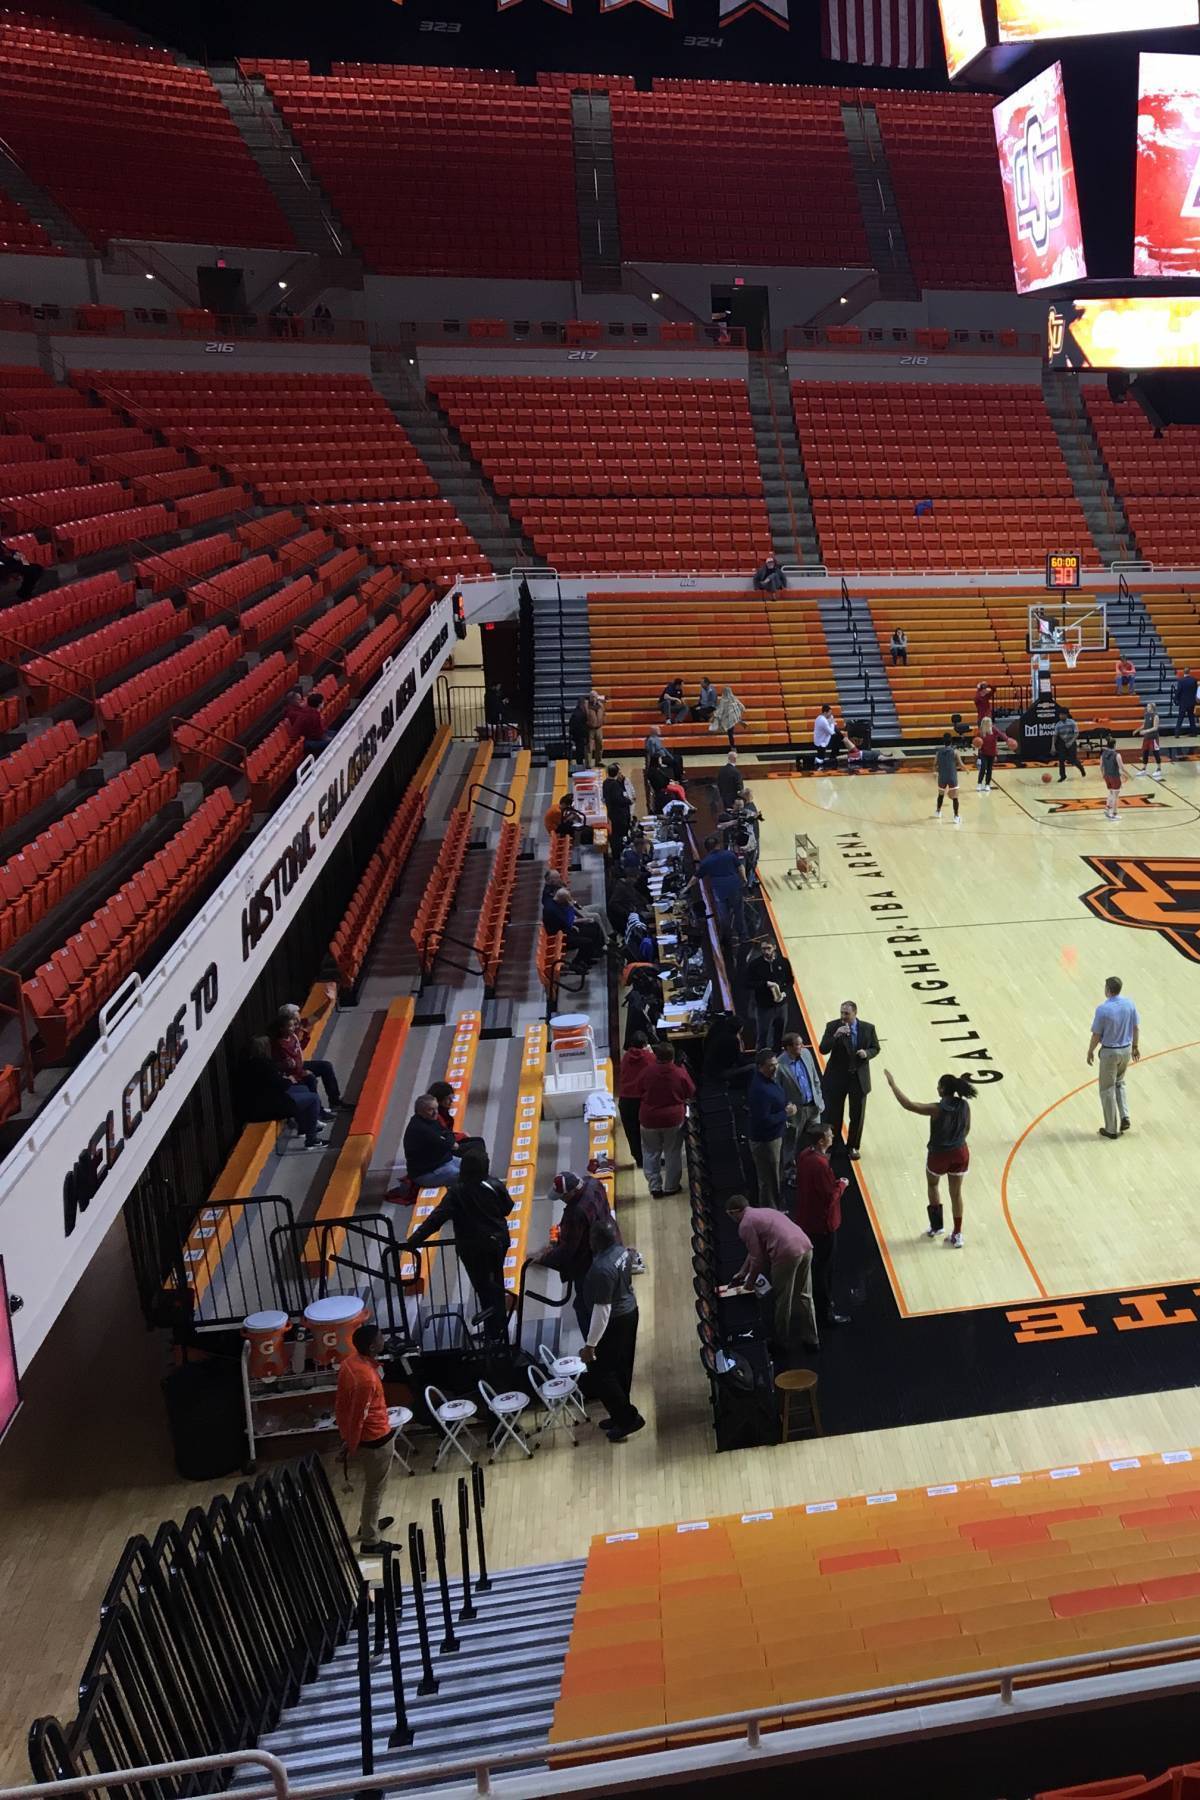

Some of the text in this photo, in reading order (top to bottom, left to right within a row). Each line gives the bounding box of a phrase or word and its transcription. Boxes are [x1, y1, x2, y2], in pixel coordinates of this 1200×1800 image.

[419, 20, 461, 33] 323
[683, 36, 723, 47] 324
[1012, 111, 1065, 255] OSU
[206, 342, 235, 353] 216
[568, 350, 598, 360] 217
[900, 355, 928, 365] 218
[1051, 557, 1077, 567] 60:00
[1055, 567, 1073, 585] 30
[833, 831, 885, 878] ARENA
[63, 1003, 189, 1239] WELCOME
[190, 961, 219, 1031] TO
[241, 811, 317, 963] HISTORIC
[323, 1332, 337, 1346] G
[260, 1340, 274, 1355] G
